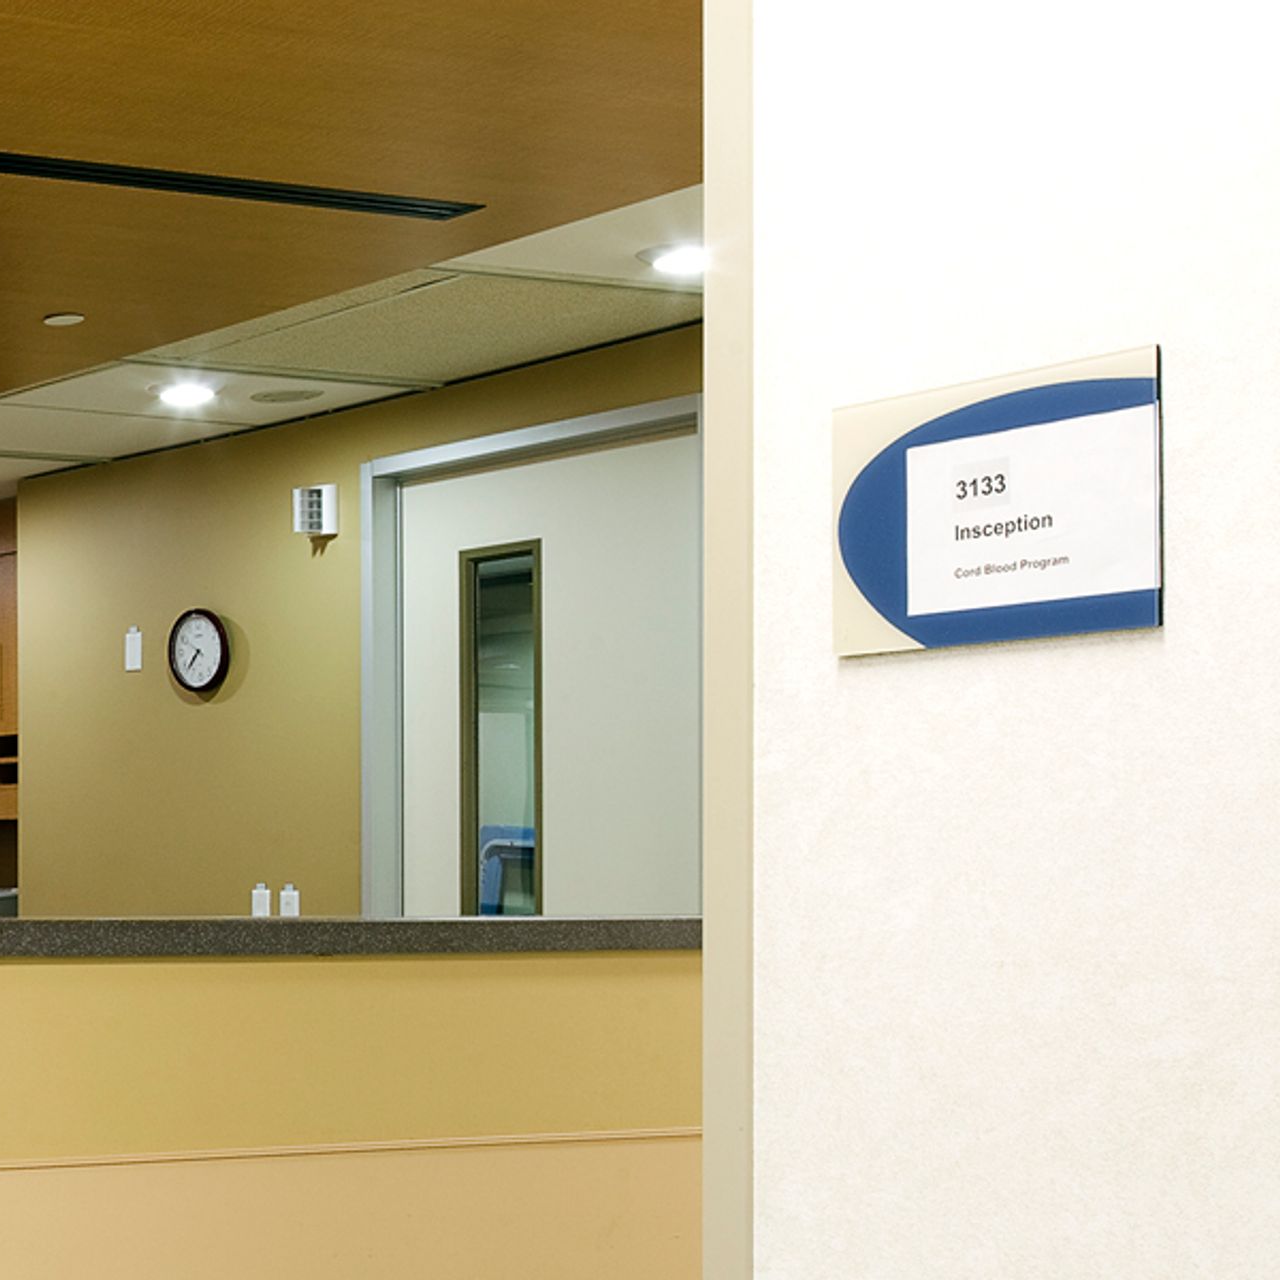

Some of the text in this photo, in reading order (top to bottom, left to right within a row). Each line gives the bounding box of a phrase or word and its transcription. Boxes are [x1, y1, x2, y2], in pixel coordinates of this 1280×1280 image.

[955, 473, 1007, 500] 3133
[954, 512, 1054, 541] Insception
[953, 554, 1070, 580] Cord Blood Program
